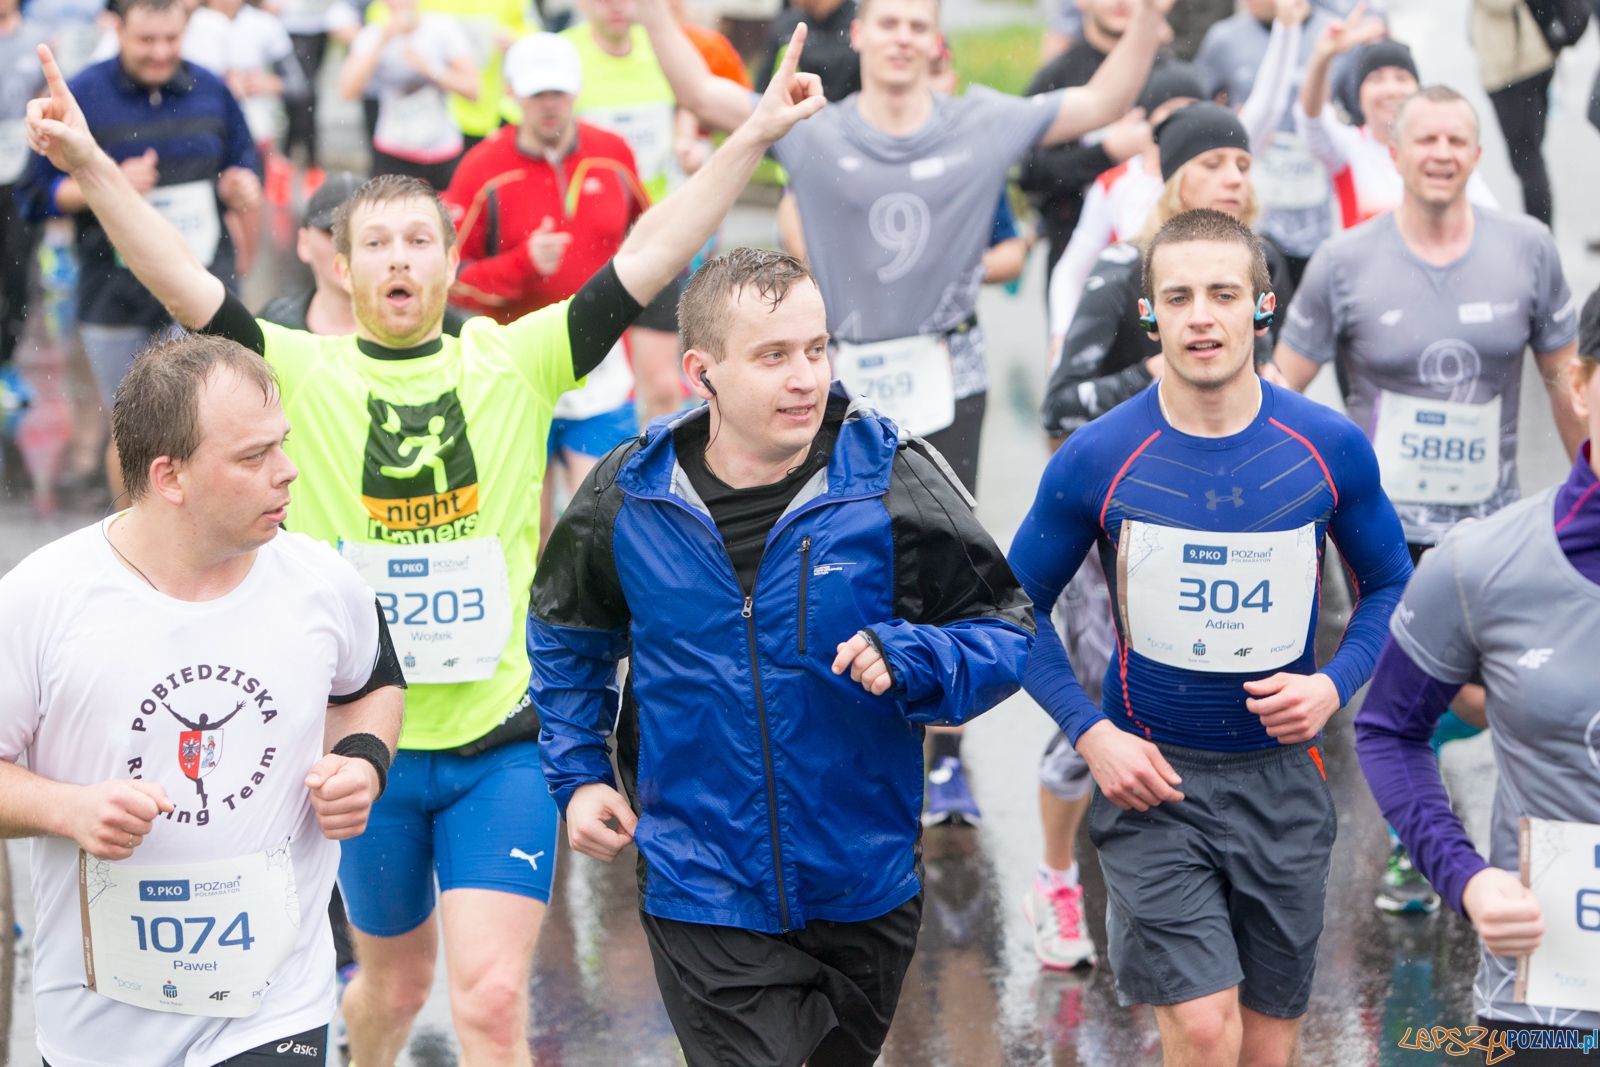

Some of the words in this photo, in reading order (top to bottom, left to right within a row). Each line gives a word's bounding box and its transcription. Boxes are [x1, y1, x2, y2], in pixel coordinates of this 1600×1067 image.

[1400, 433, 1486, 463] 5886
[387, 492, 460, 526] night
[1179, 577, 1273, 613] 304
[410, 632, 452, 643] Wojtek
[1205, 619, 1244, 630] Adrian
[131, 664, 278, 732] POBIEDZISKA
[222, 747, 276, 811] Team
[131, 911, 255, 954] 1074
[173, 960, 218, 971] Paweł
[208, 990, 231, 1001] 4F
[292, 1043, 318, 1057] asics
